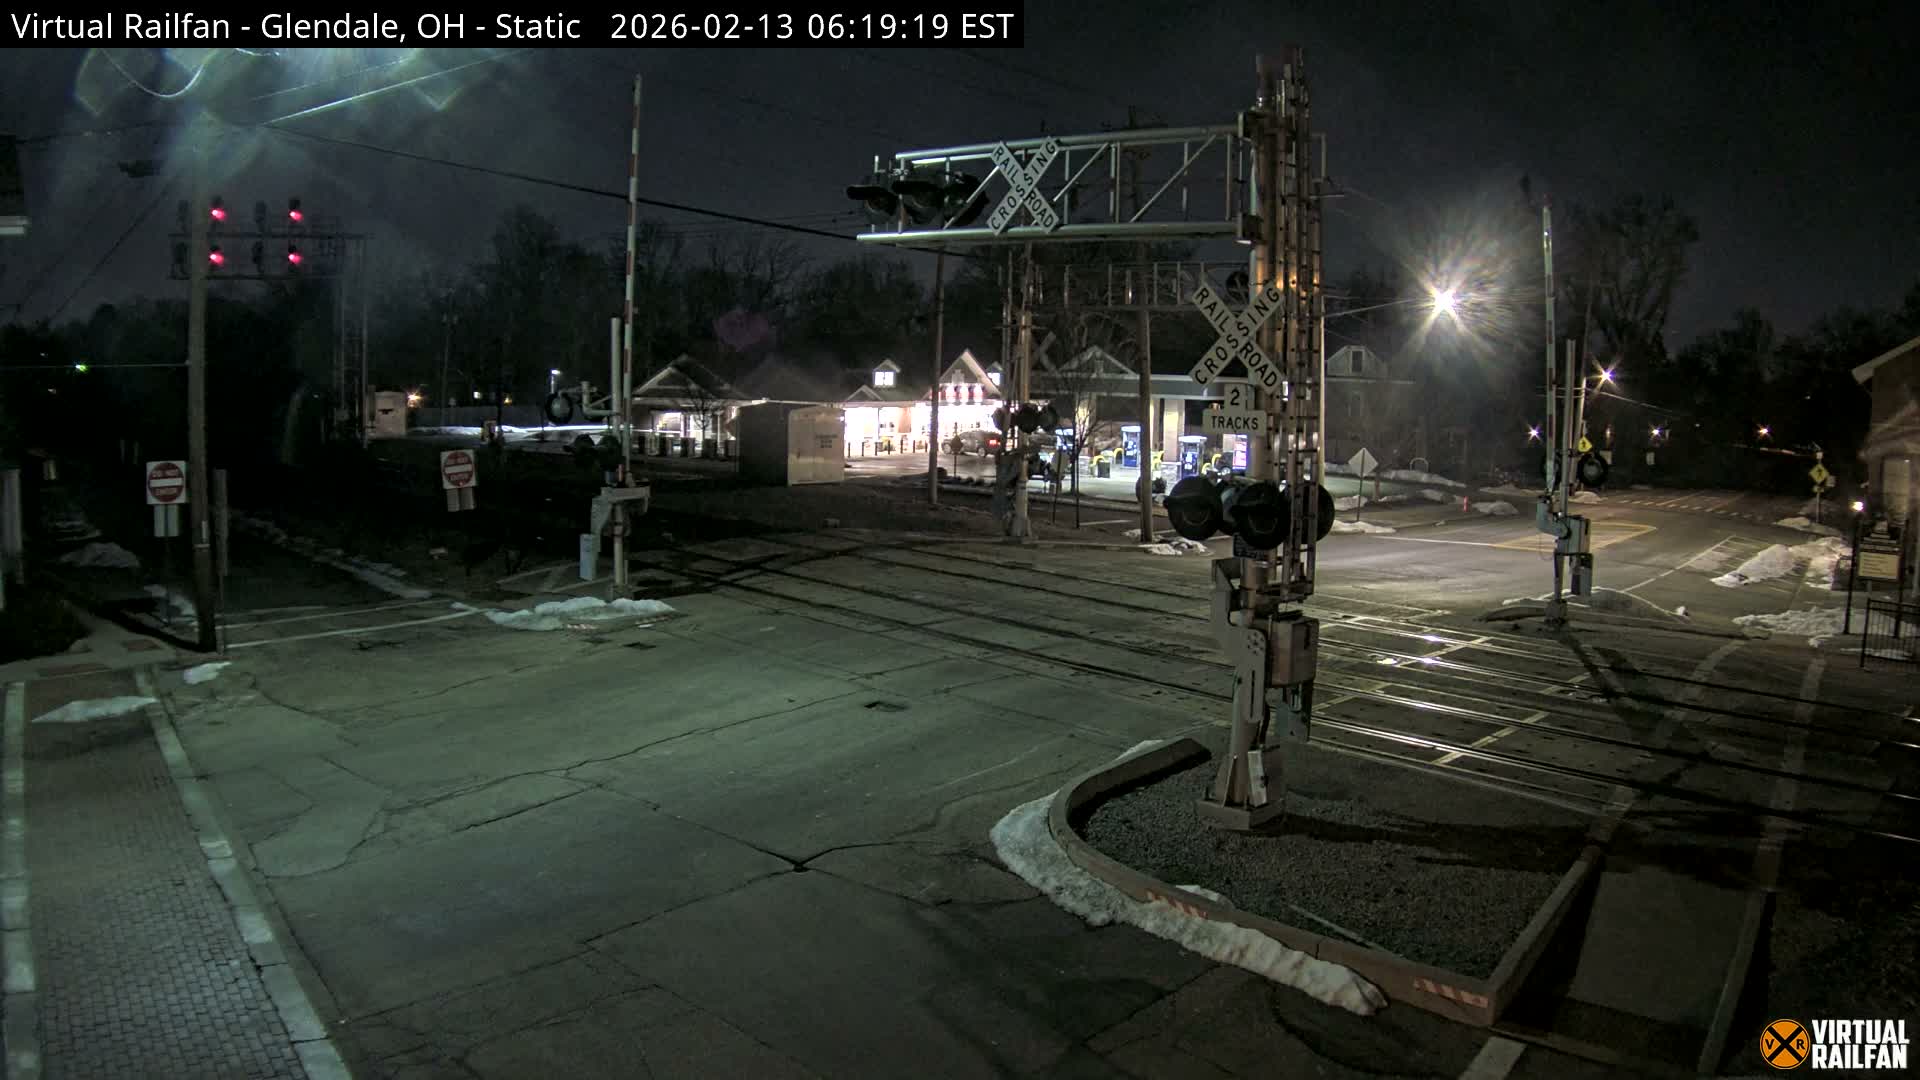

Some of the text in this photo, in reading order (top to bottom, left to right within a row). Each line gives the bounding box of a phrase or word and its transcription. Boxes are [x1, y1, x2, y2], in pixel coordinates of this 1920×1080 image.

[991, 142, 1056, 230] CROSSING
[994, 146, 1054, 228] RAILROAD
[1195, 288, 1279, 385] CROSSING
[1195, 287, 1278, 388] RAILROAD
[1211, 415, 1258, 430] TRACKS
[1229, 388, 1240, 406] 2
